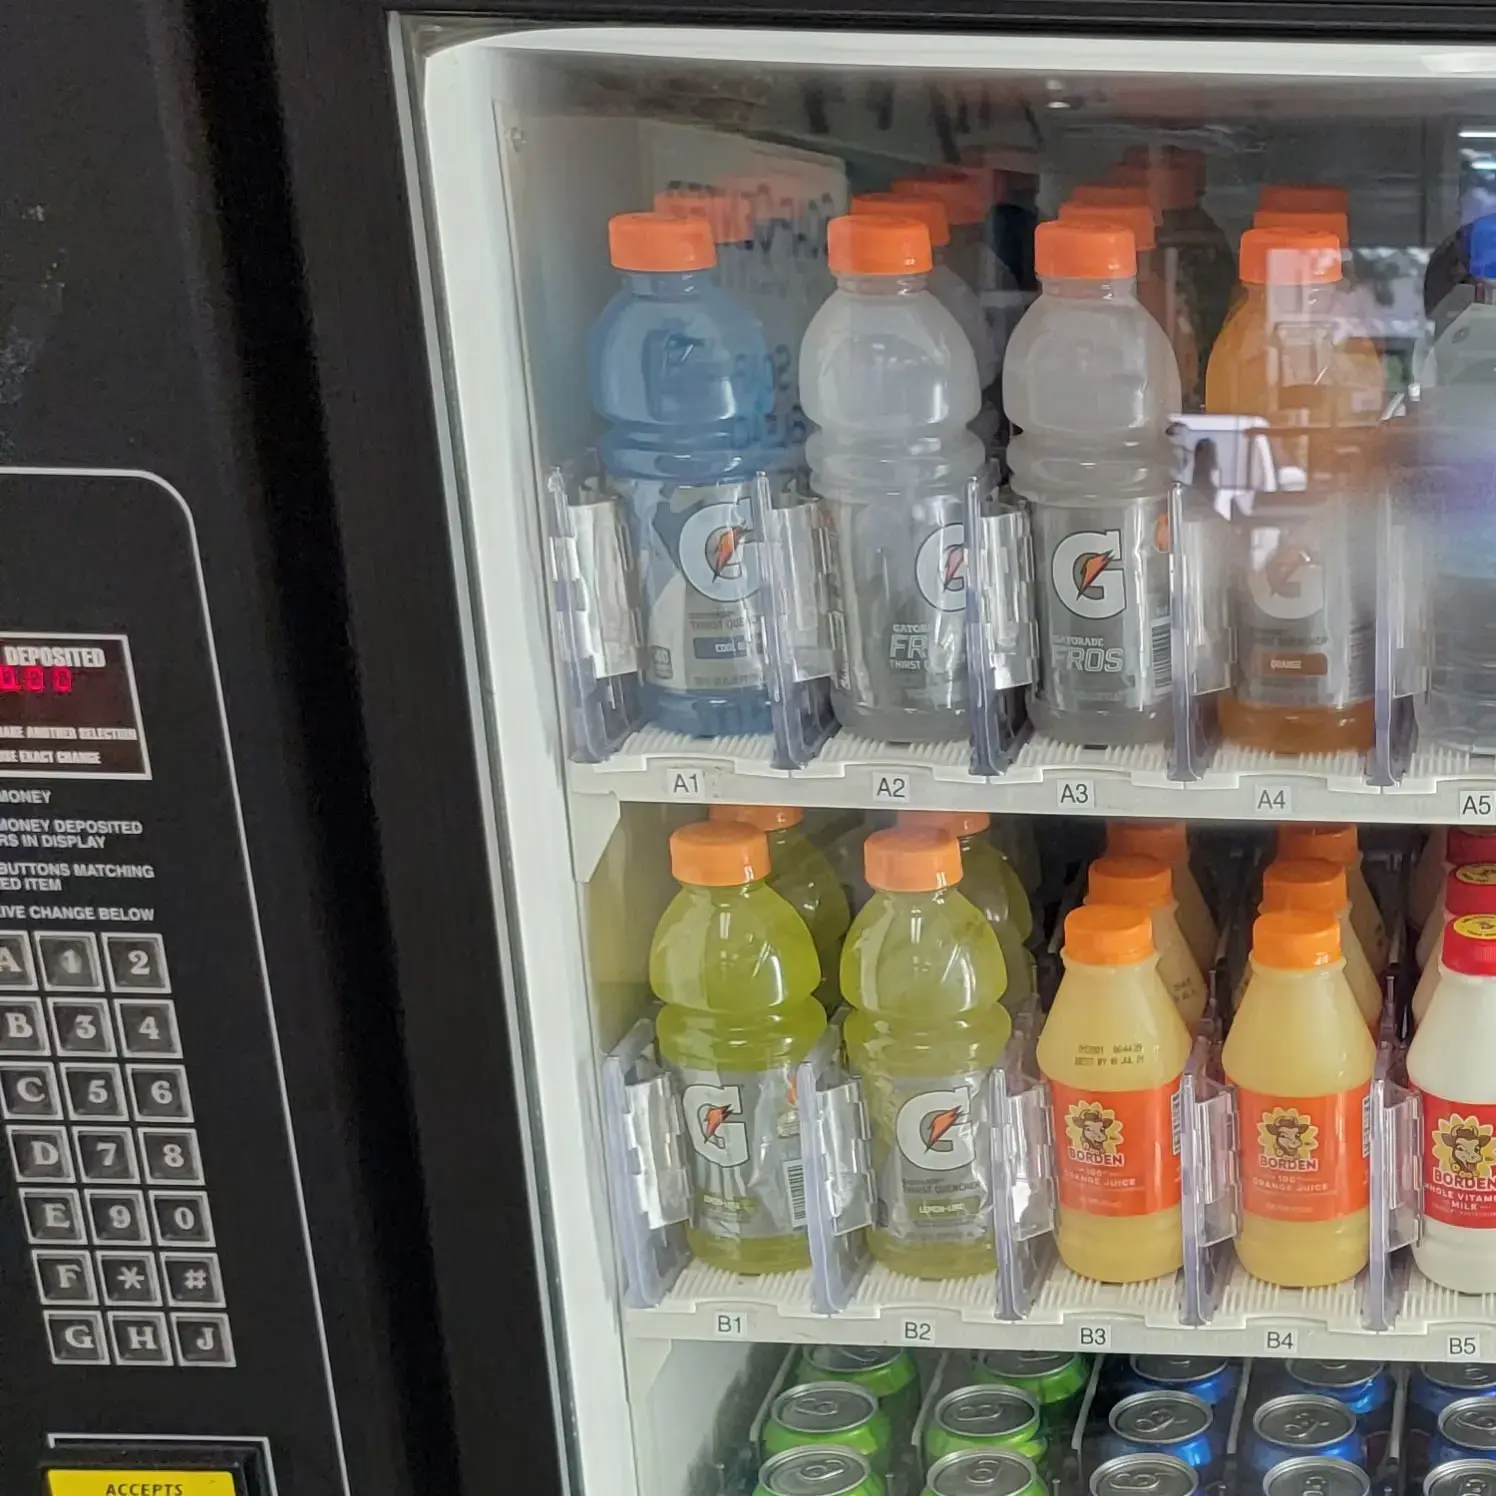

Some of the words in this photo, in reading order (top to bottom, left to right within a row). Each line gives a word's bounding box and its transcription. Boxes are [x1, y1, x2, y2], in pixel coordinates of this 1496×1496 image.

[4, 646, 106, 668] DEPOSITED
[19, 751, 54, 763] EXACT
[672, 773, 699, 793] A1
[876, 777, 906, 798] A2
[1060, 783, 1089, 804] A3
[1258, 789, 1286, 809] A4
[1462, 795, 1491, 815] A5
[54, 820, 143, 835] DEPOSITED
[22, 835, 39, 847] IN
[42, 835, 106, 849] DISPLAY
[73, 864, 155, 878] MATCHING
[24, 878, 63, 891] ITEM
[29, 906, 96, 920] CHANGE
[98, 907, 155, 921] BELOW
[0, 952, 21, 973] A
[63, 949, 80, 975] 1
[128, 950, 150, 976] 2
[7, 1013, 33, 1038] B
[75, 1015, 97, 1040] 3
[139, 1016, 161, 1041] 4
[17, 1076, 45, 1103] C
[89, 1079, 108, 1104] 5
[151, 1081, 173, 1105] 6
[31, 1140, 59, 1167] D
[96, 1142, 117, 1167] 7
[163, 1144, 185, 1169] 8
[1069, 1147, 1123, 1166] BORDEN
[1260, 1155, 1318, 1172] BORDEN
[1104, 1178, 1136, 1187] JUICE
[1297, 1182, 1328, 1192] JUICE
[1451, 1200, 1477, 1211] MILK
[45, 1203, 71, 1229] E
[109, 1204, 131, 1230] 9
[174, 1206, 195, 1231] 0
[57, 1264, 82, 1289] F
[717, 1315, 742, 1334] B1
[904, 1321, 931, 1340] B2
[64, 1324, 95, 1349] G
[128, 1326, 157, 1351] H
[196, 1327, 216, 1351] J
[1080, 1327, 1106, 1345] B3
[1267, 1331, 1294, 1350] B4
[1449, 1337, 1476, 1355] B5
